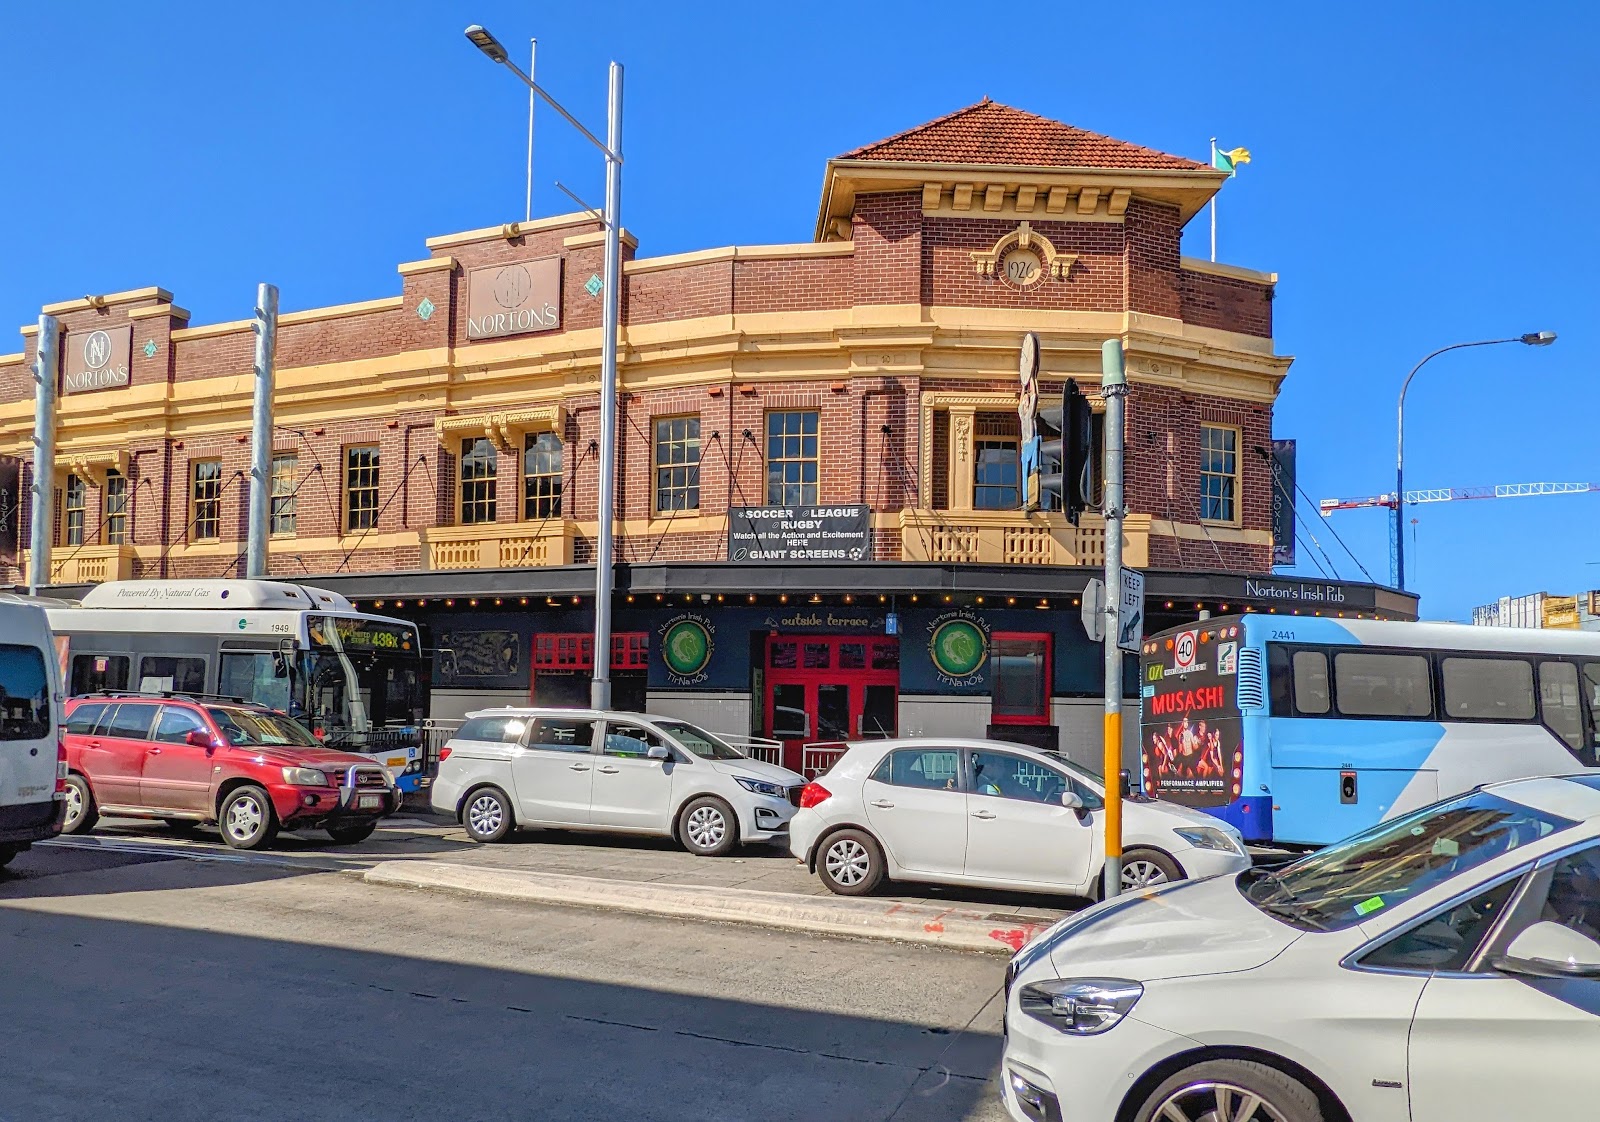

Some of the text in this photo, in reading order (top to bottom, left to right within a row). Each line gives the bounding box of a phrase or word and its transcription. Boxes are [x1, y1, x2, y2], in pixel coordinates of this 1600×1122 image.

[1008, 261, 1035, 279] 1926
[468, 302, 557, 337] NORTON'S
[66, 363, 128, 390] NORTON'S
[745, 508, 859, 519] SOCCER LEAGUE
[780, 520, 823, 530] RUGBY
[733, 530, 864, 540] Watch all the Action and Excitement
[749, 549, 846, 559] GIANT SCREENS
[1123, 574, 1141, 591] KEEP
[117, 587, 211, 600] Powered By Natural Gas
[1246, 580, 1345, 603] Norton's Irish Pub
[1124, 592, 1140, 608] LEFT
[703, 618, 716, 634] Pub
[781, 612, 869, 626] outside terrace
[976, 616, 991, 633] Pub
[270, 624, 290, 633] 1949
[1271, 630, 1295, 640] 2441
[1178, 640, 1193, 658] 40
[1152, 684, 1225, 715] MUSASHI
[1195, 779, 1224, 787] AMPLIFIED
